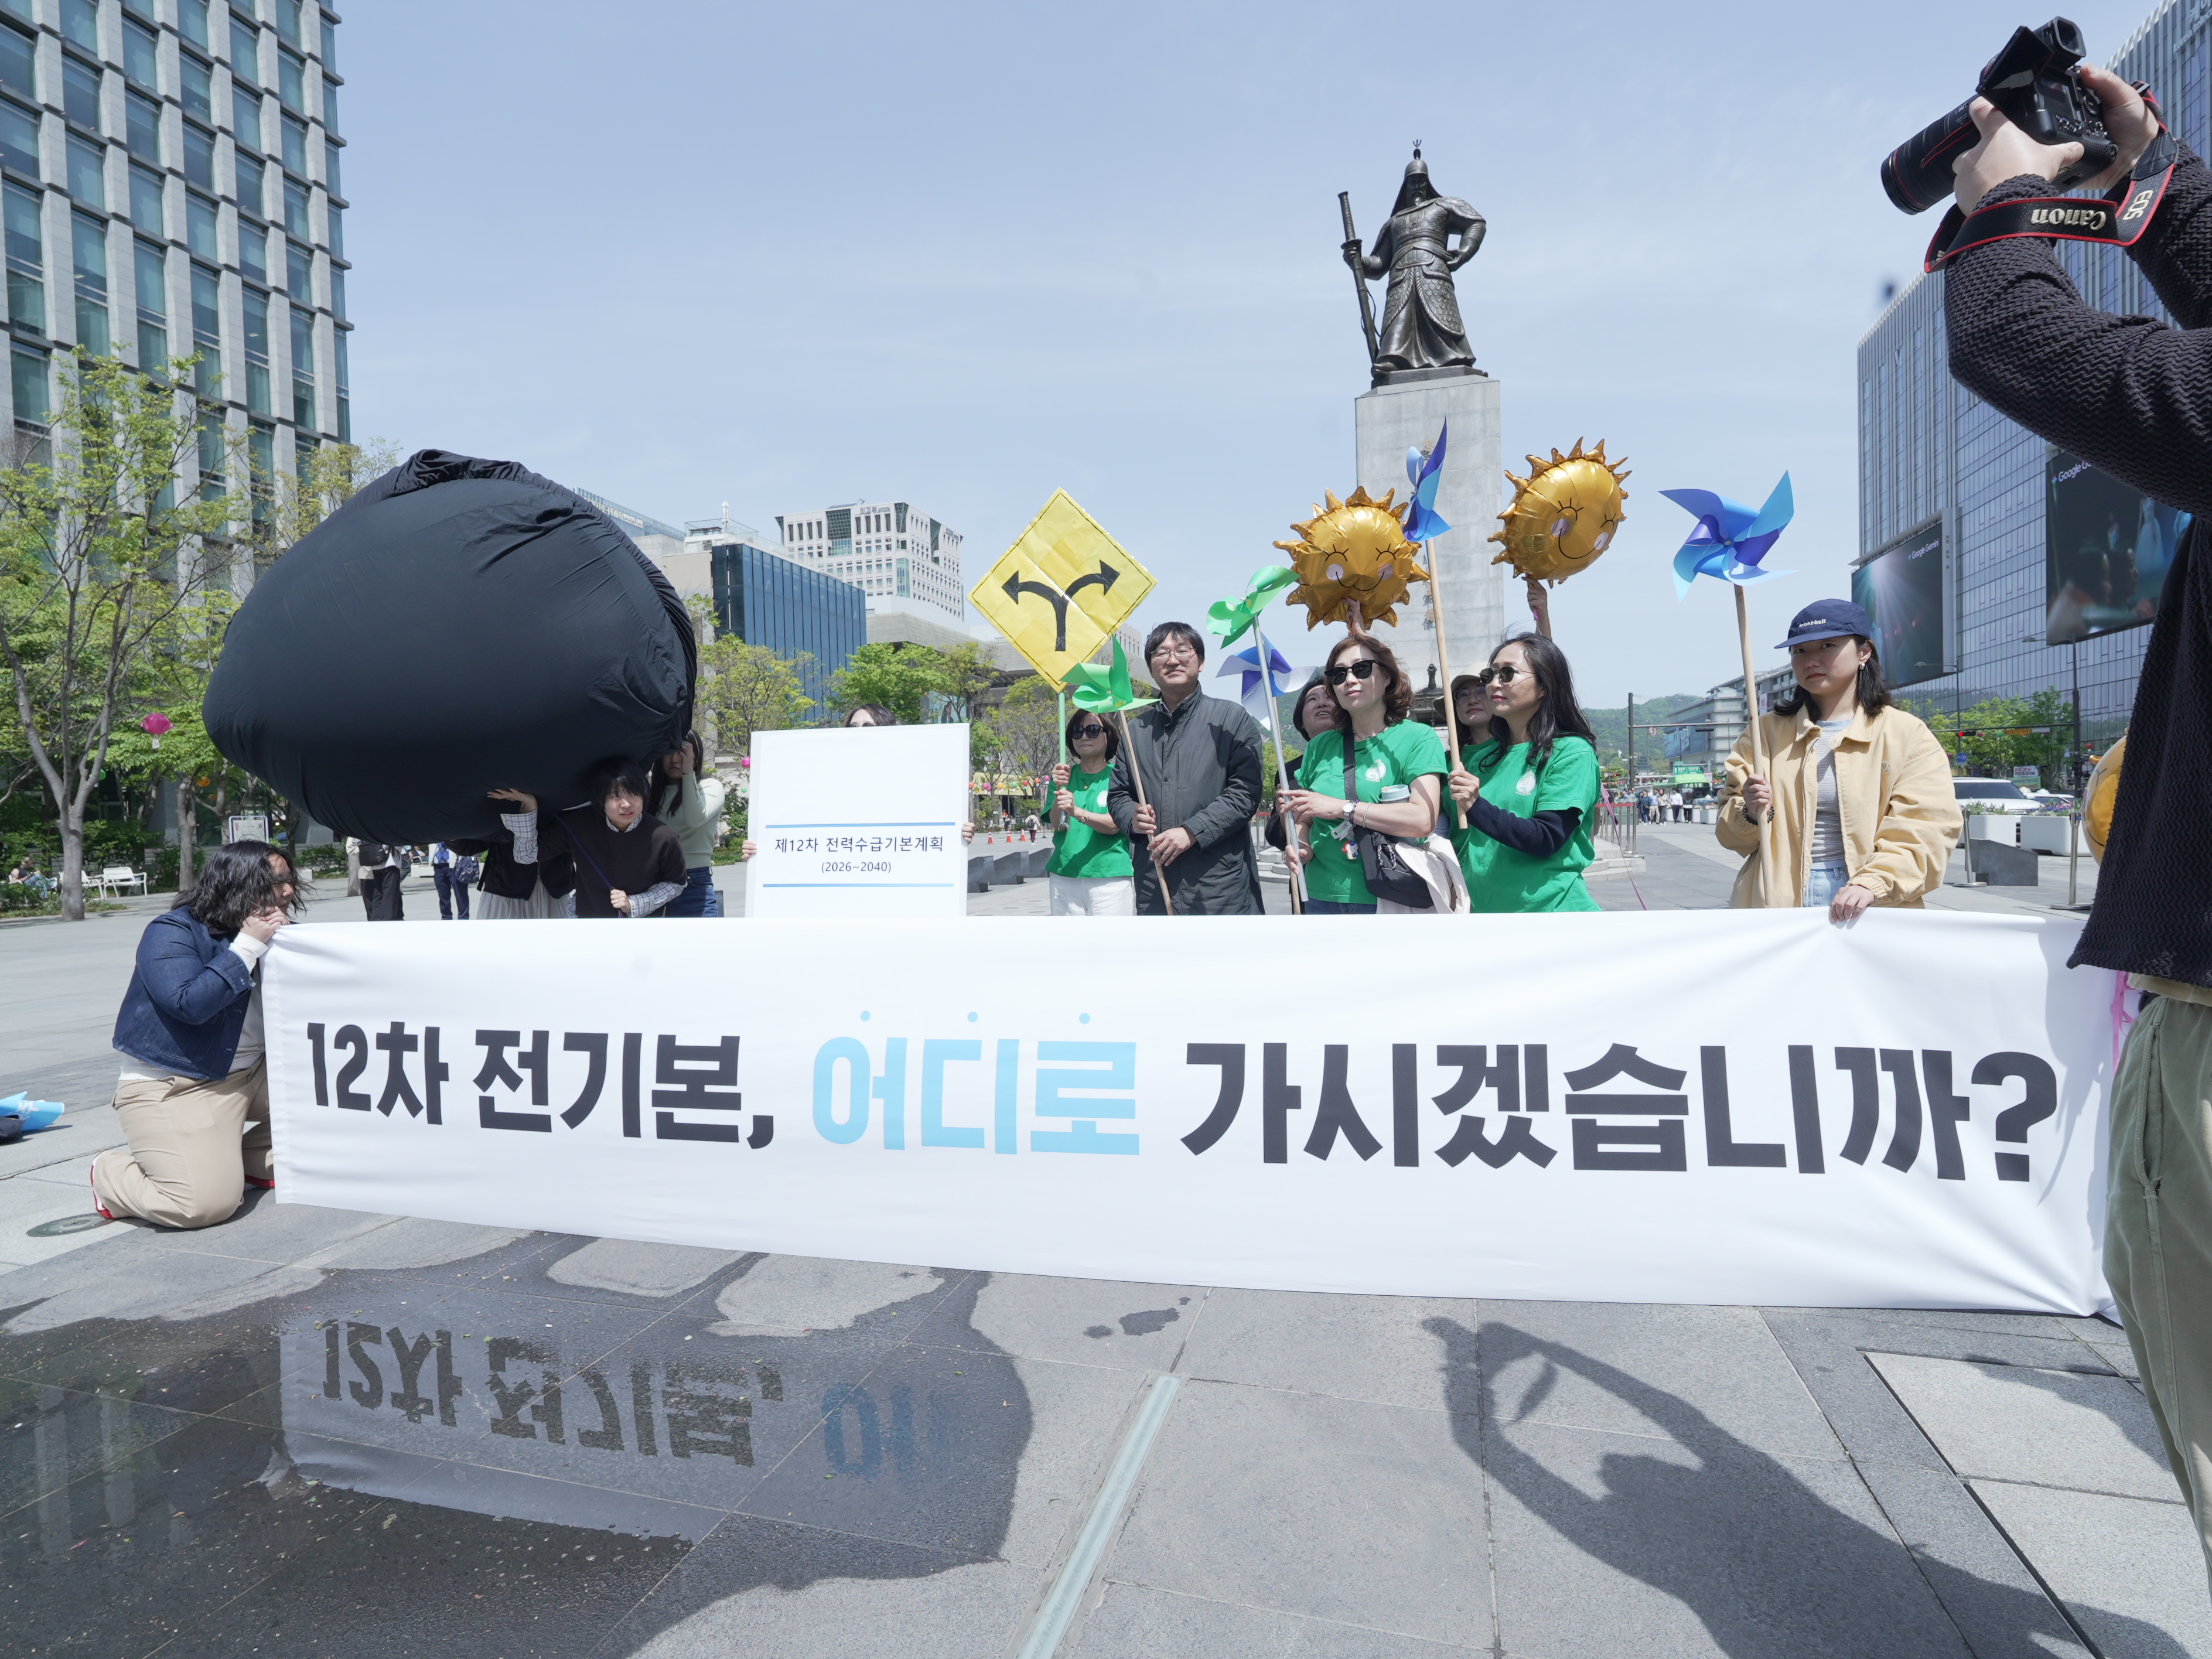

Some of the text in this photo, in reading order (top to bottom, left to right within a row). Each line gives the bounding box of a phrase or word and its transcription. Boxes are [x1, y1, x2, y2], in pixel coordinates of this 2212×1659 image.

[2122, 189, 2153, 220] EOS
[2030, 208, 2107, 230] Canon
[2059, 463, 2081, 482] Google
[774, 836, 943, 853] 제12차 전력수급기본계획
[821, 862, 892, 873] (2026~2040)
[307, 1022, 2057, 1182] 12차 전기본, 어디로 가시겠습니까?
